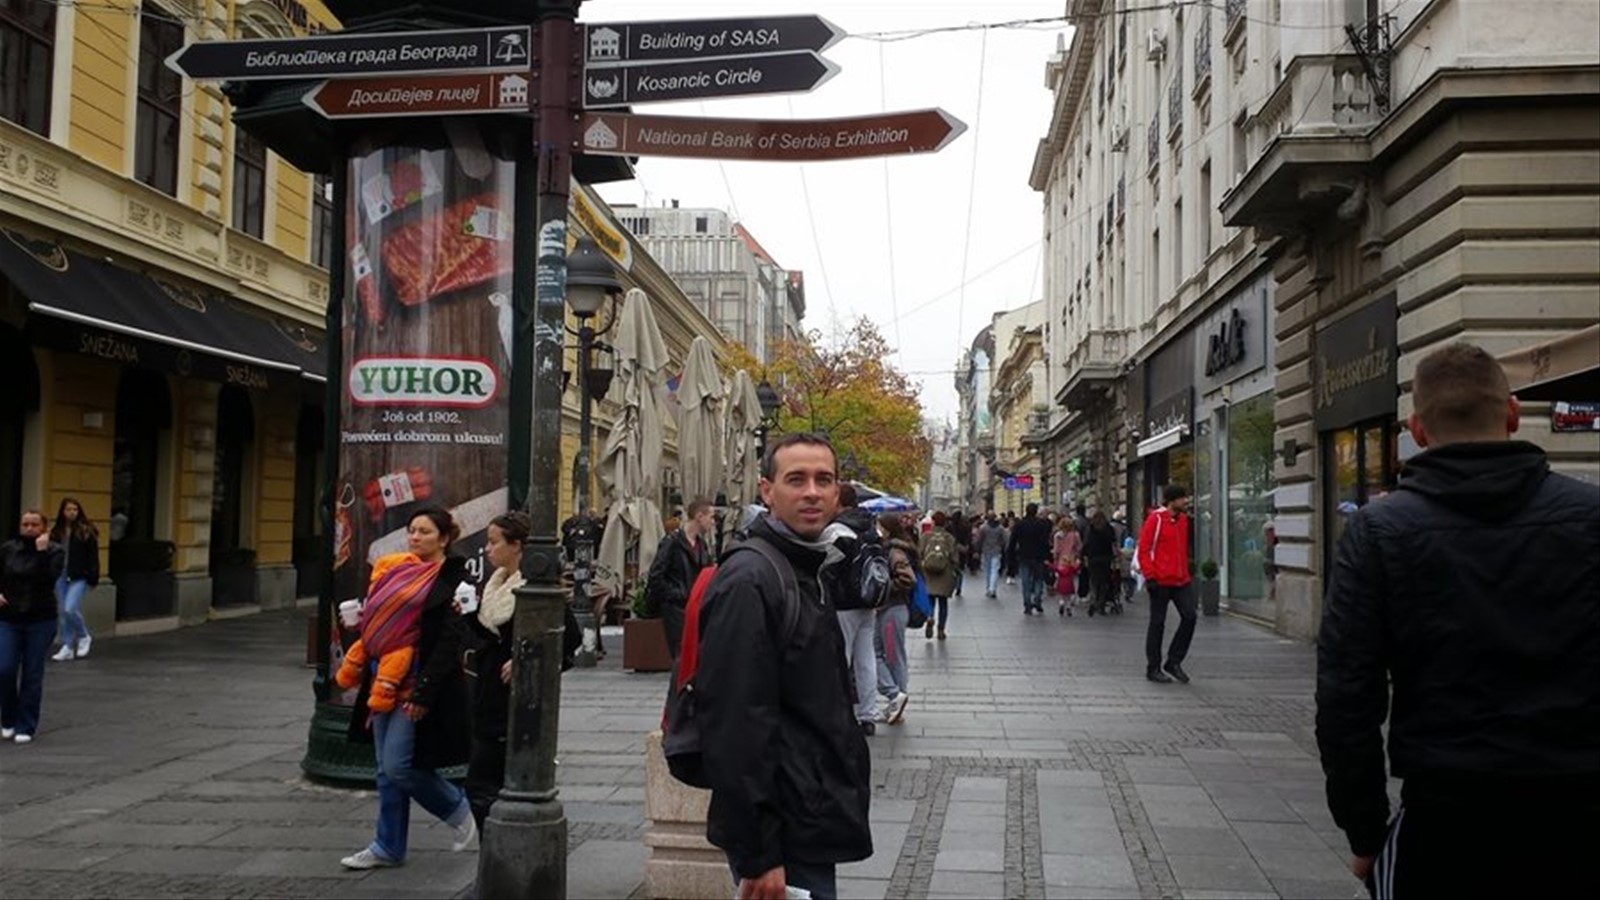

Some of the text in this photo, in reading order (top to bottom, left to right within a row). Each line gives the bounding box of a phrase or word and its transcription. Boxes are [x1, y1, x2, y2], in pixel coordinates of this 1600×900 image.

[639, 29, 780, 50] Building of SASA
[246, 43, 478, 67] Библиотека града Београда
[637, 68, 762, 92] Kosancic Circle
[347, 85, 480, 107] Доситејев лицеј
[637, 126, 909, 149] National Bank of Serbia Exhibition
[359, 366, 488, 396] YUHOR
[382, 411, 462, 424] Još od 1902.
[394, 430, 450, 443] dobrom
[455, 431, 504, 444] ukusu!
